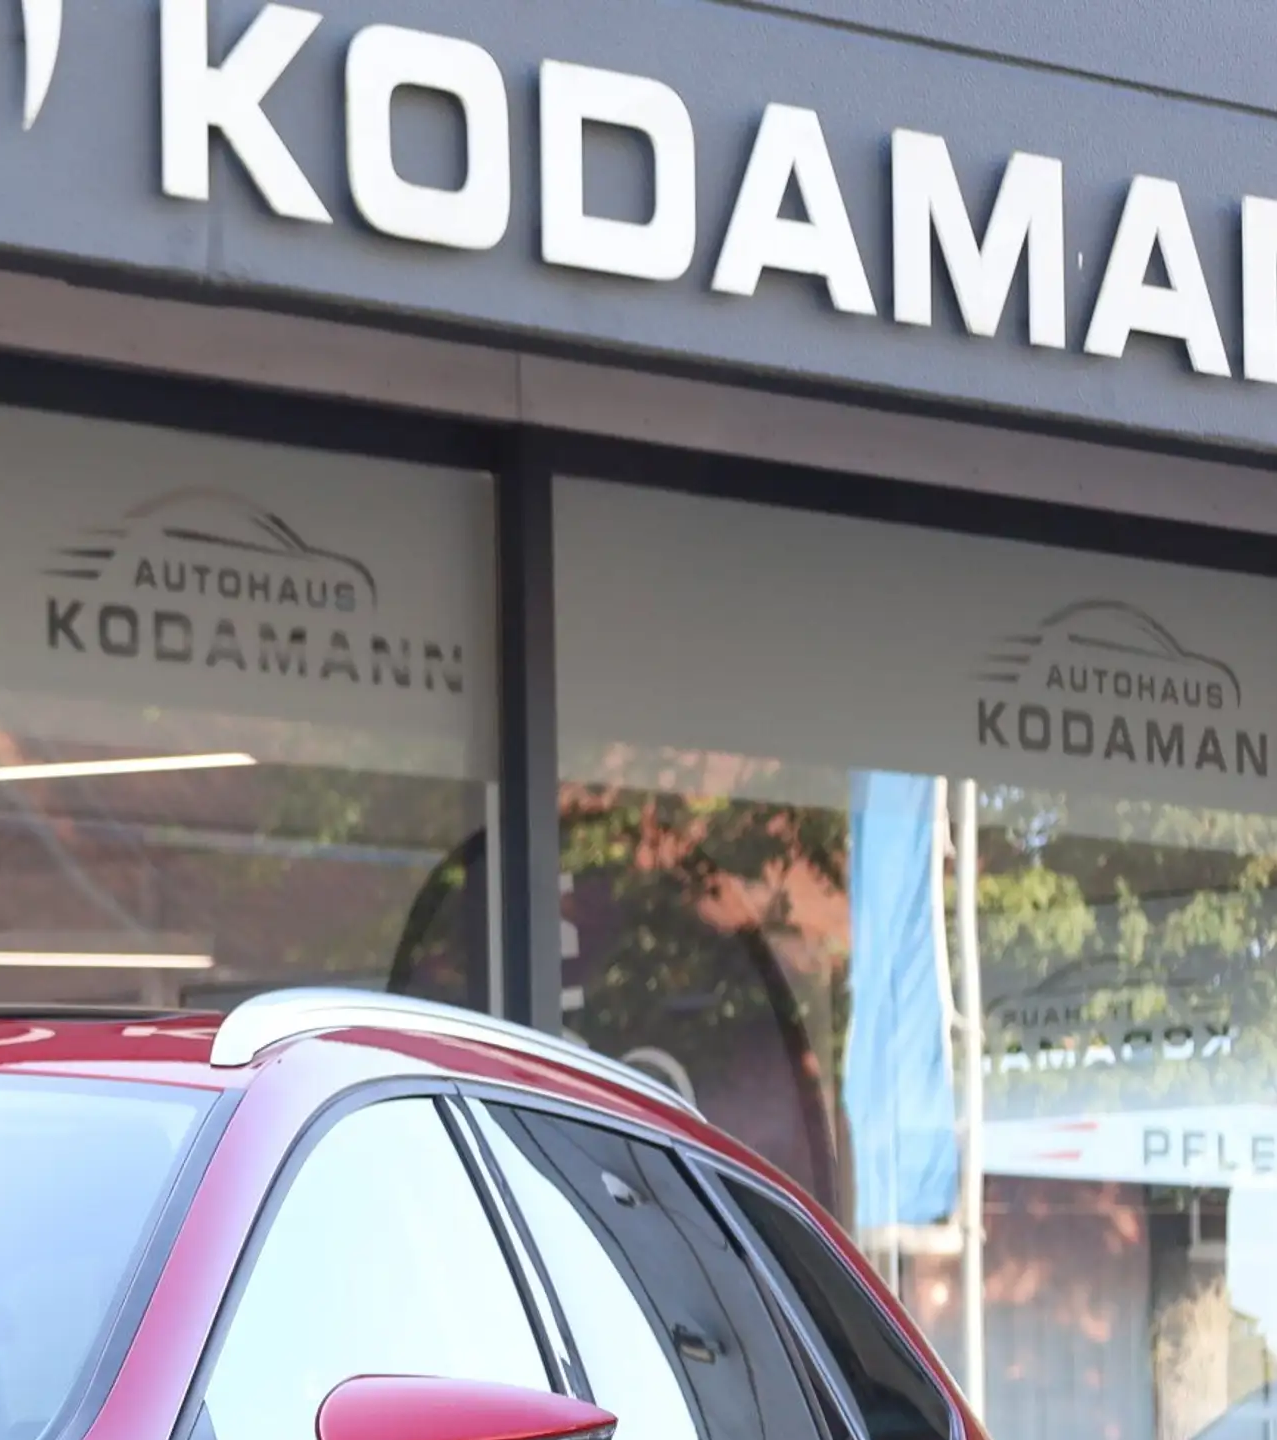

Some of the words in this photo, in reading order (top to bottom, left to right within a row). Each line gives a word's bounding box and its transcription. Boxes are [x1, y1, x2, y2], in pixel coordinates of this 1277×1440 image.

[160, 0, 1277, 382] KODAMA
[134, 556, 357, 613] AUTOHAUS
[47, 596, 463, 693] KODAMANN
[1046, 664, 1224, 709] AUTOHAUS
[977, 697, 1270, 778] KODAMAN
